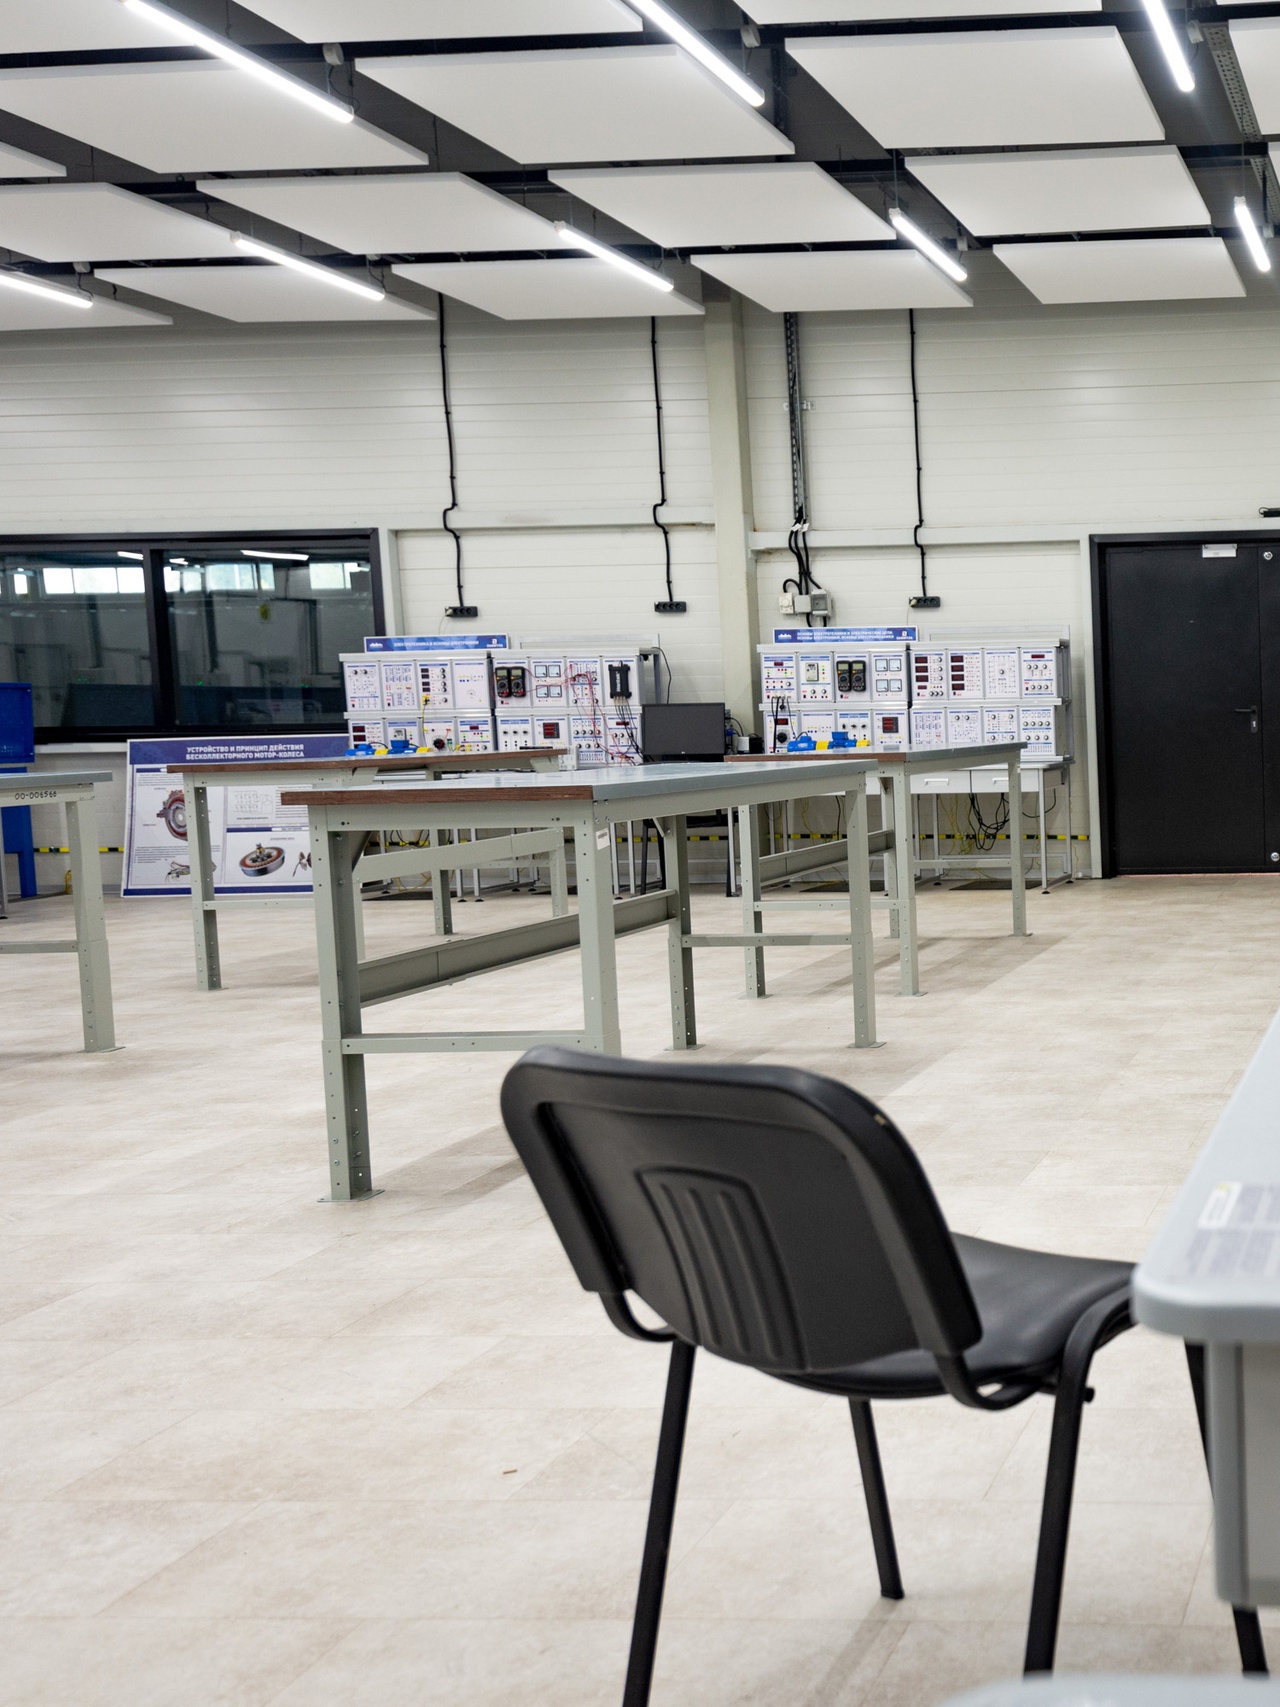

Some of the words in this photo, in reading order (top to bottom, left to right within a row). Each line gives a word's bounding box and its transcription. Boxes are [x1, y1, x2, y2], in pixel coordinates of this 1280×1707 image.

[187, 745, 229, 753] УСТРОЙСТВО
[236, 744, 268, 752] ПРИНЦИП
[269, 743, 304, 751] ДЕЙСТВИЯ
[186, 752, 253, 760] БЕСКОЛЛЕКТОРНОГО
[254, 751, 304, 759] МОТОР-КОЛЕСА
